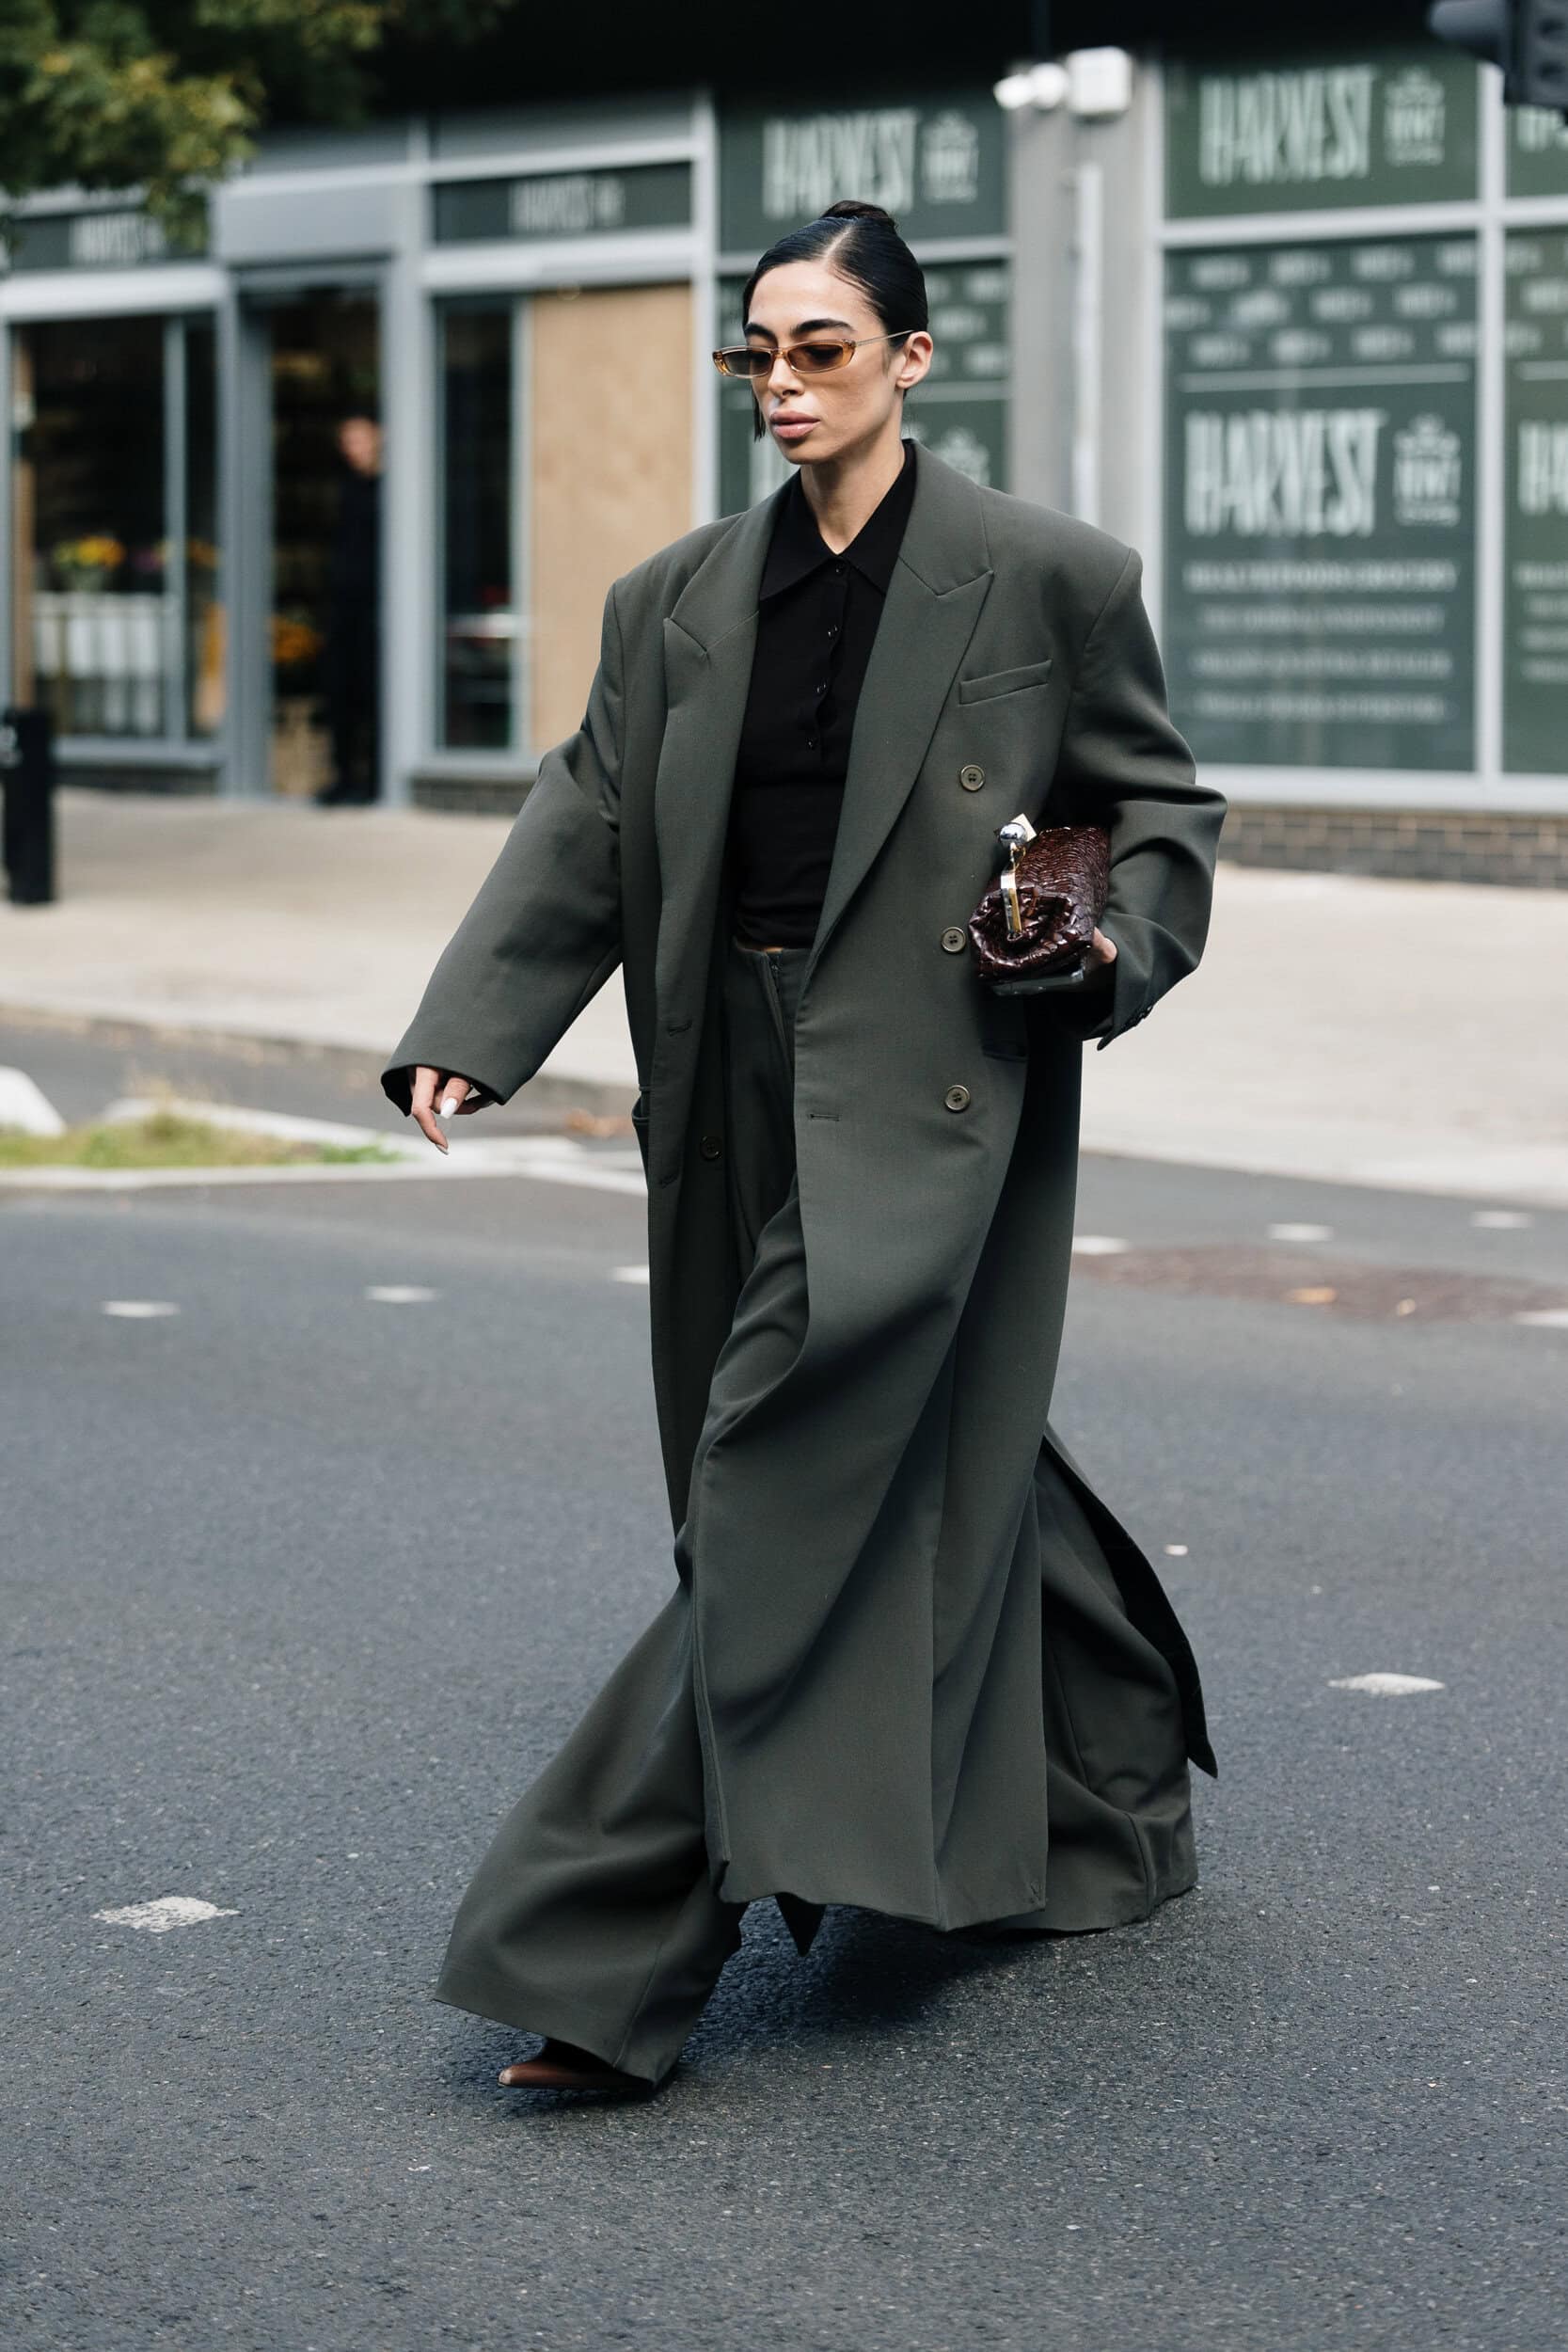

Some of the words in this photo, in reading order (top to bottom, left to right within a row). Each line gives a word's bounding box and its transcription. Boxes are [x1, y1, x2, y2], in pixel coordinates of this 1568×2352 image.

[763, 108, 917, 219] HARVEST
[1199, 65, 1375, 185] HARVEST
[1184, 408, 1386, 537] HARVEST
